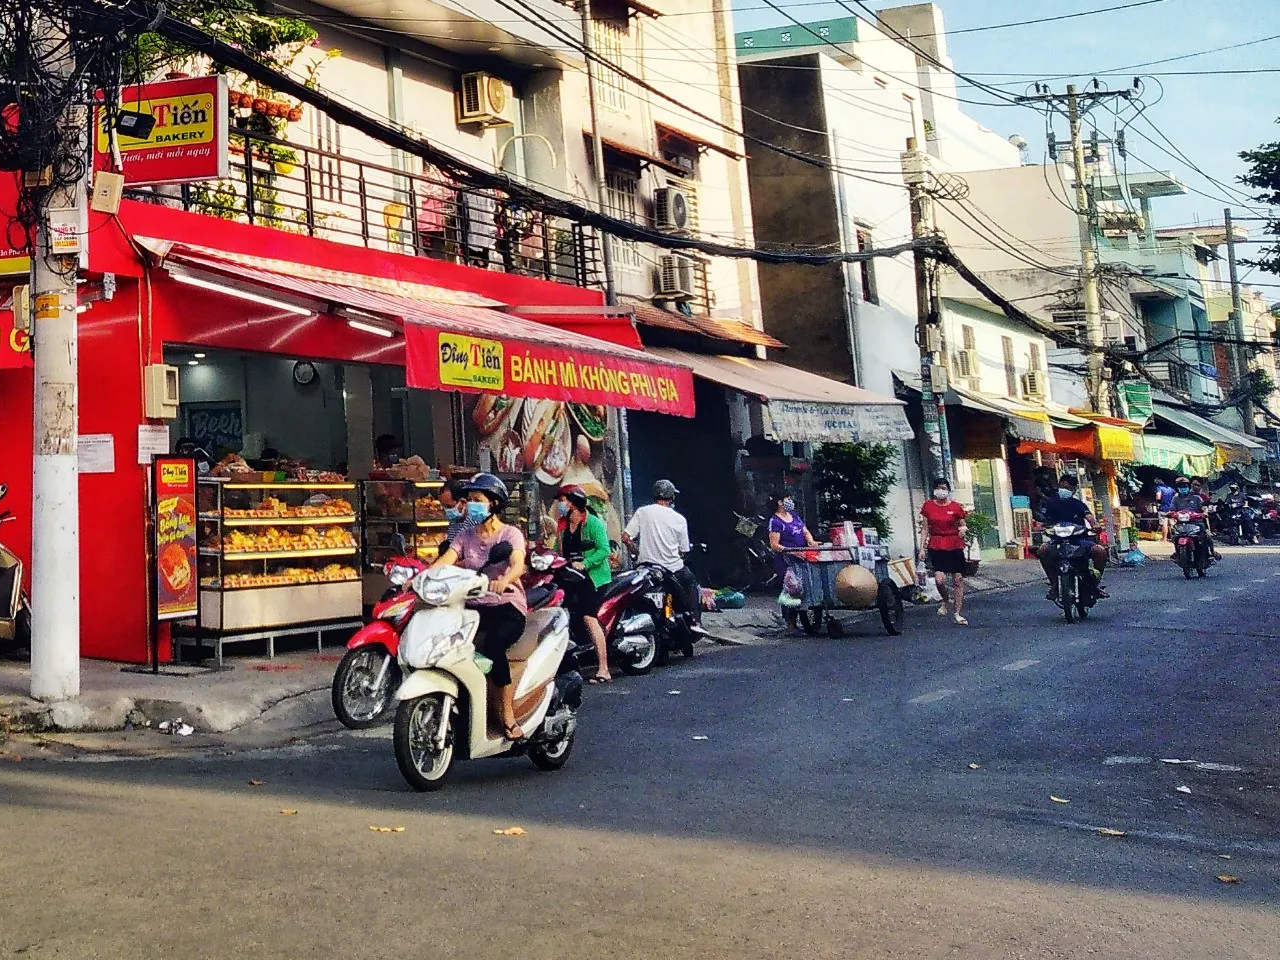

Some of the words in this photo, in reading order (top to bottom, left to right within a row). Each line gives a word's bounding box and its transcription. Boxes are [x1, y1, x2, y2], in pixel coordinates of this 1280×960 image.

[152, 98, 208, 129] Tiến
[155, 130, 206, 143] BAKERY
[186, 146, 212, 158] ngày
[440, 342, 469, 371] Đồng
[470, 342, 502, 371] Tiến
[471, 373, 501, 386] BAKERY
[510, 349, 558, 386] BÁNH
[559, 356, 578, 387] MÌ
[579, 365, 629, 395] KHÔNG
[629, 372, 658, 404] PHỤ
[657, 376, 679, 403] GIA
